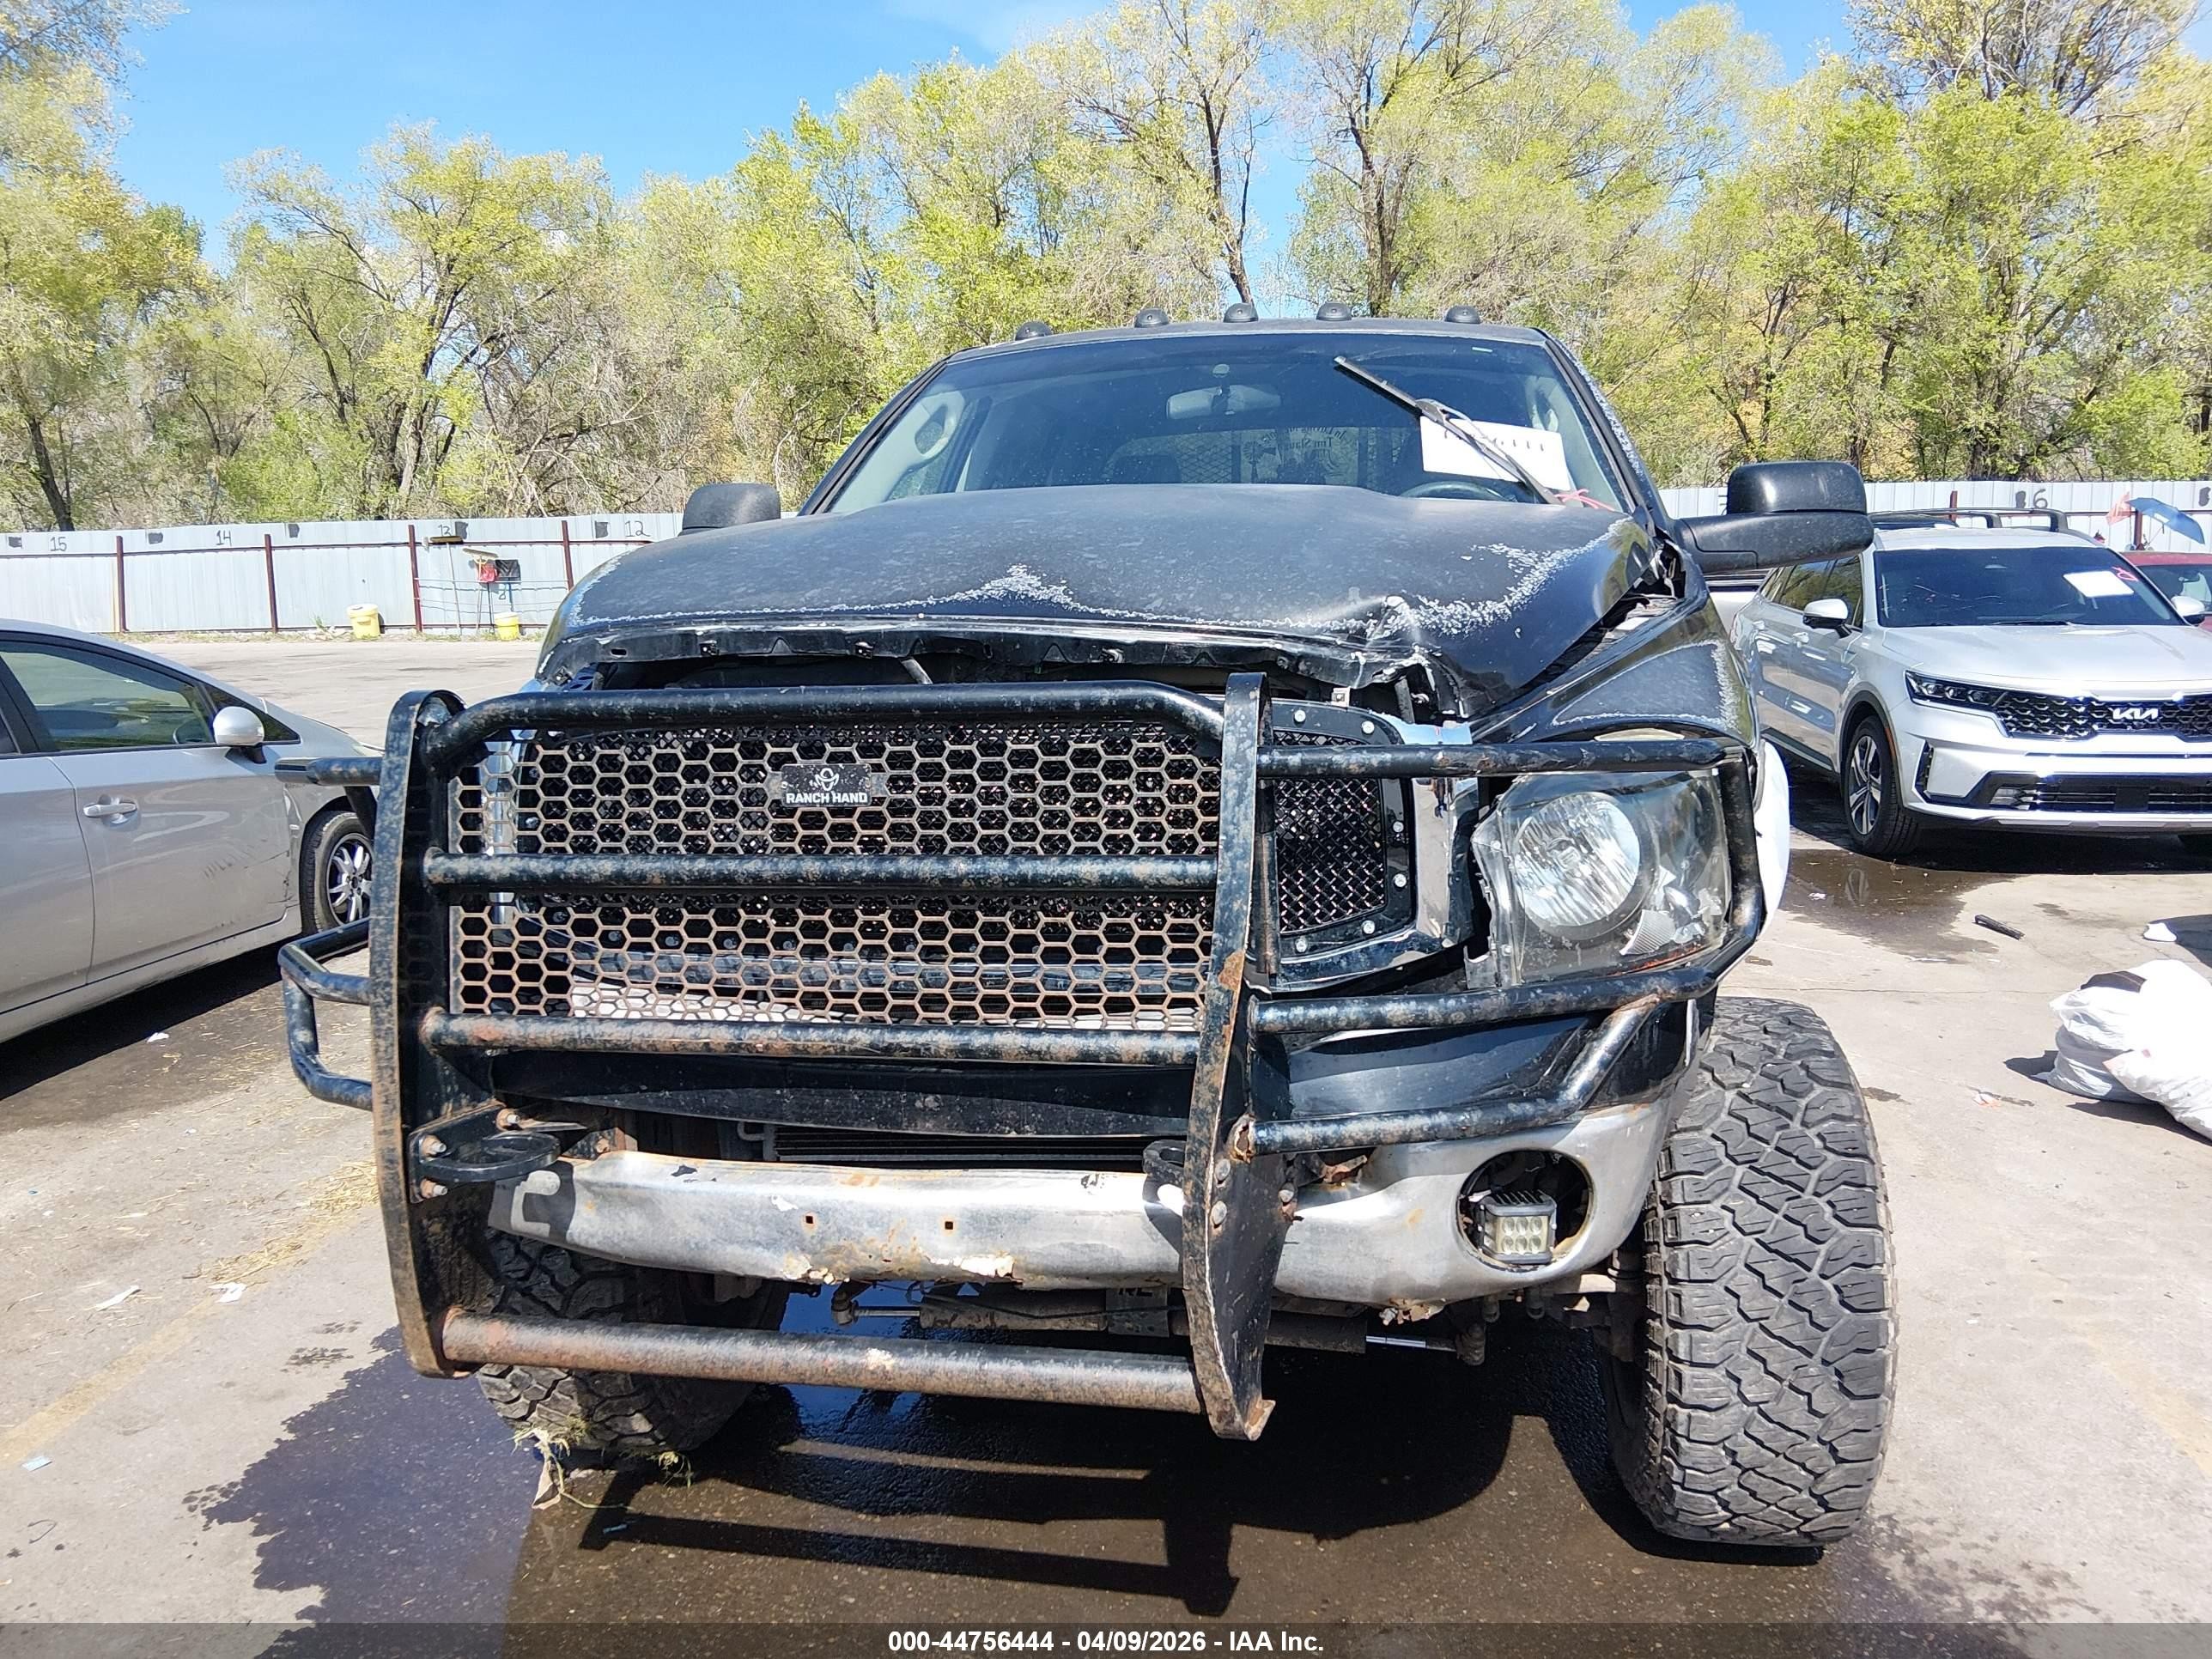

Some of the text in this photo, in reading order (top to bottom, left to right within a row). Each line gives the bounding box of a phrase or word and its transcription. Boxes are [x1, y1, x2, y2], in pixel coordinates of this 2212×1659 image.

[625, 520, 651, 538] 12
[50, 537, 67, 552] 15
[216, 530, 232, 547] 14
[786, 792, 868, 804] RANCH HAND
